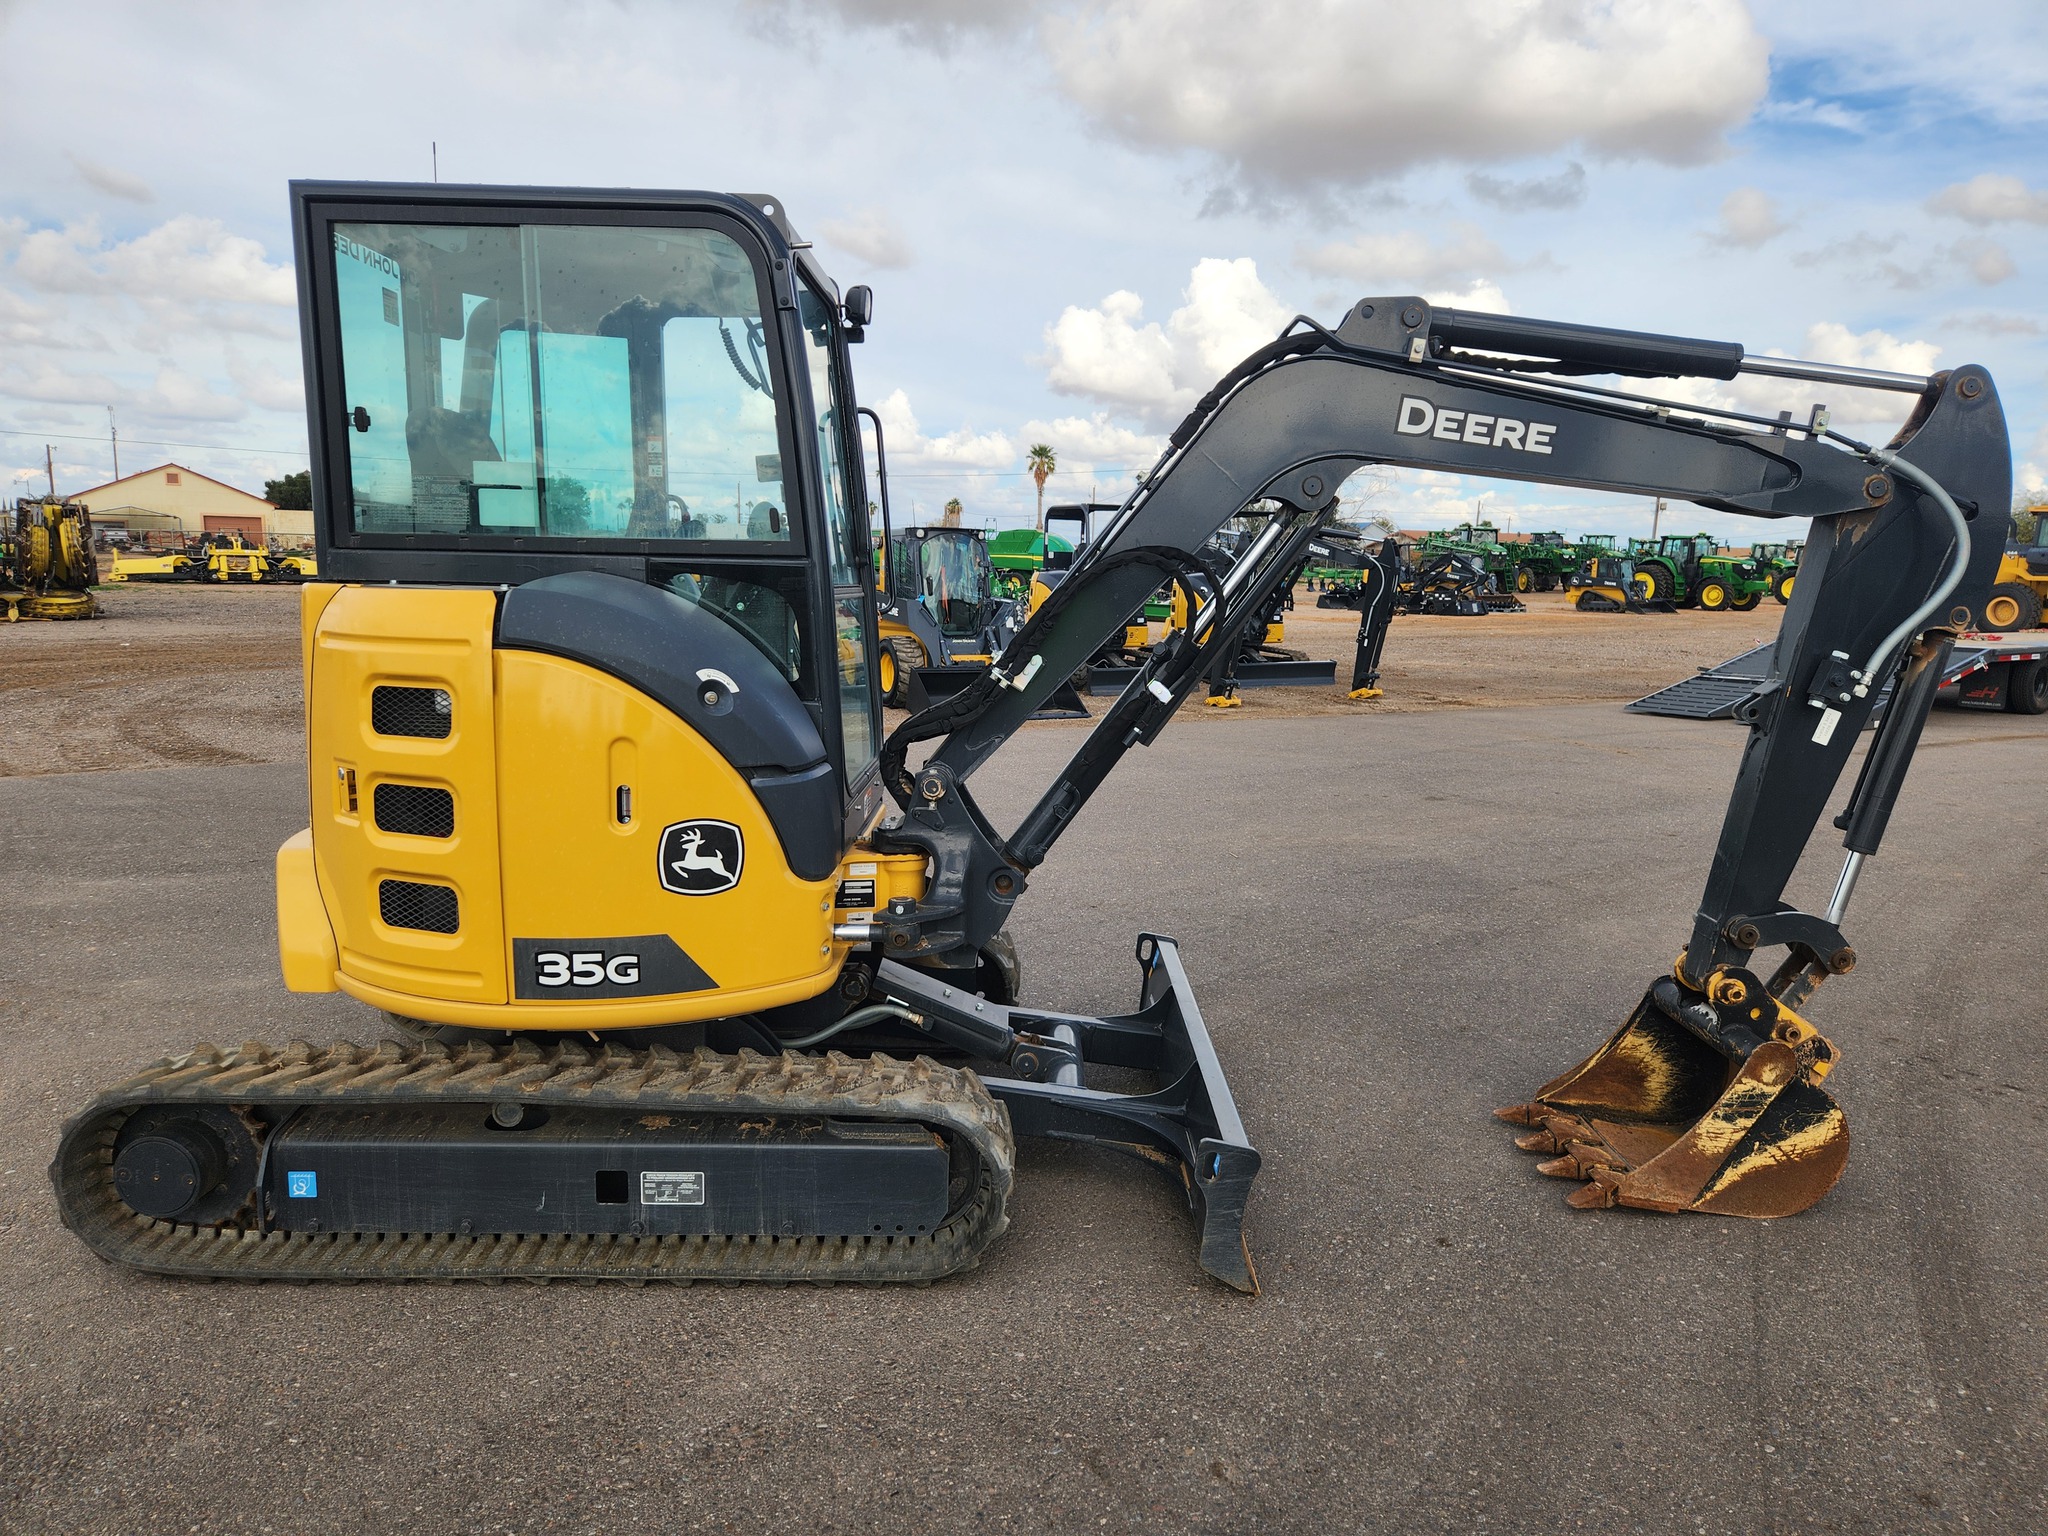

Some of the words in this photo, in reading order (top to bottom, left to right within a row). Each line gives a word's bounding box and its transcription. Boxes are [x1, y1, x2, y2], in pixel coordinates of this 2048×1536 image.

[1397, 397, 1557, 454] DEERE
[1309, 543, 1330, 556] DEERE
[537, 952, 639, 986] 35G
